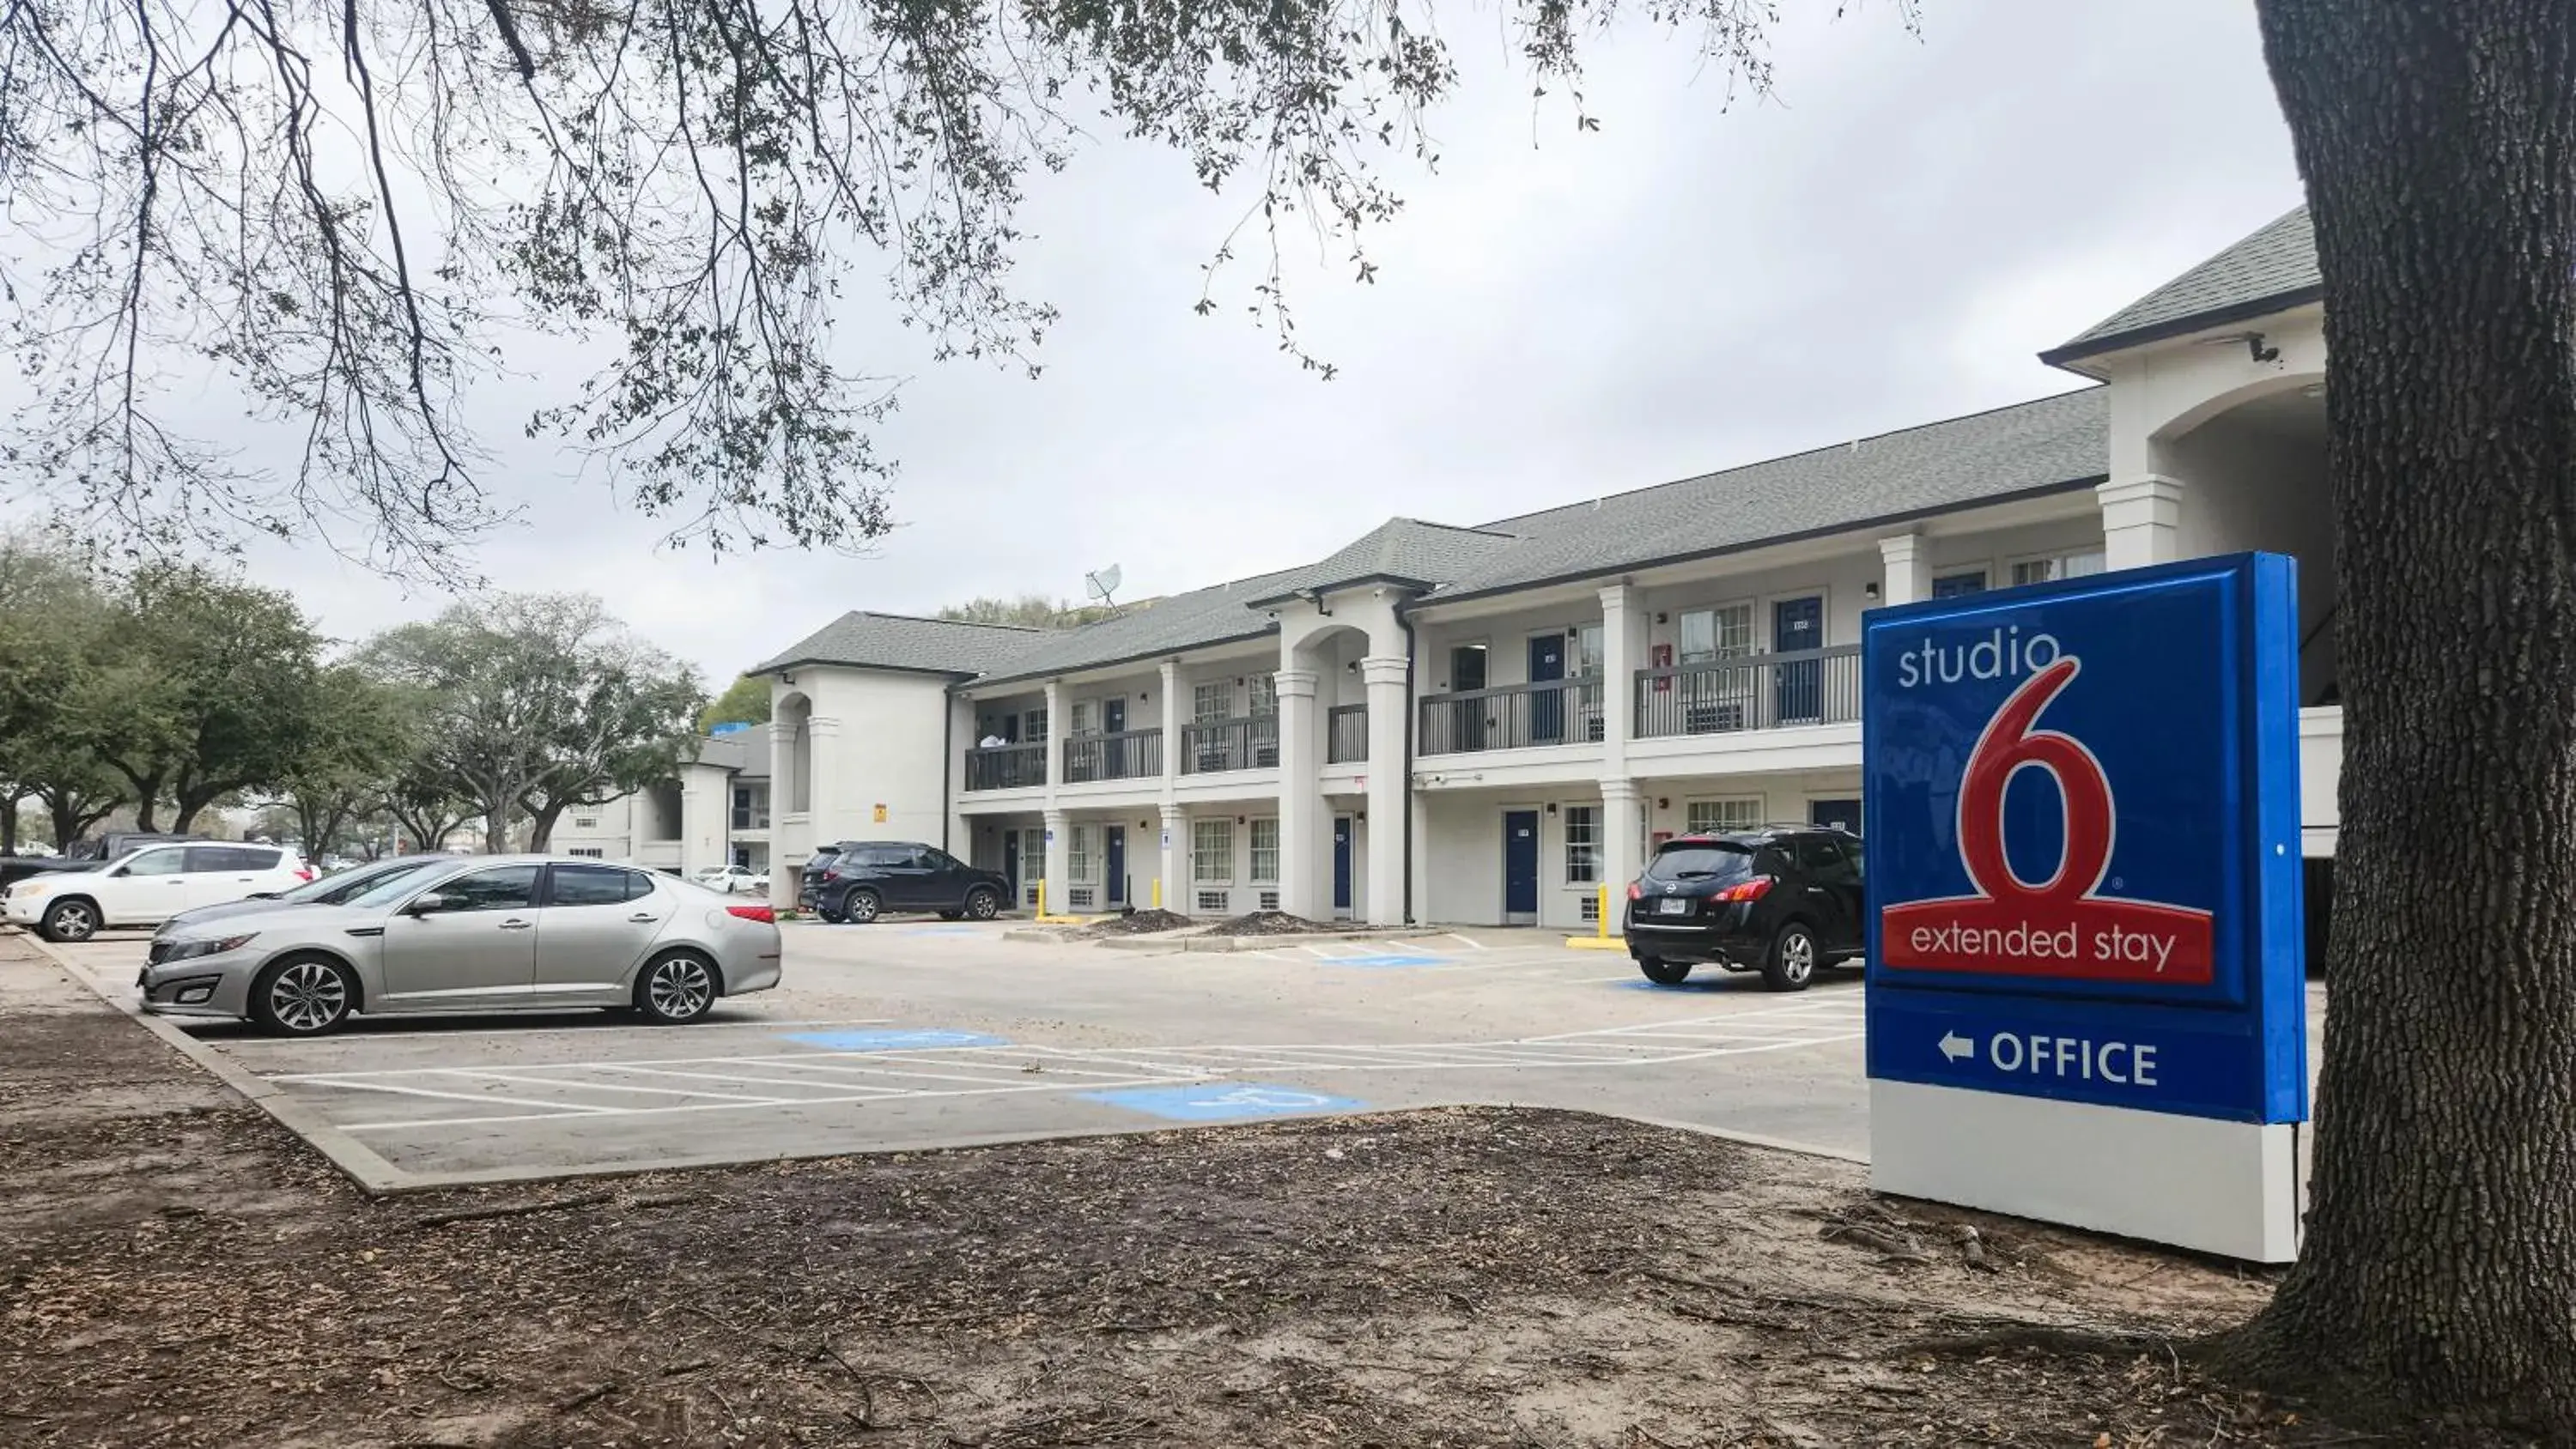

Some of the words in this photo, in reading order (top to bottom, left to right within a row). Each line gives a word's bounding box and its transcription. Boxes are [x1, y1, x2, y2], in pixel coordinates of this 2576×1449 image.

[1899, 625, 2060, 688] studio
[1956, 654, 2116, 903] 6
[1911, 920, 2077, 959] extended
[2094, 924, 2176, 973] stay
[1990, 1032, 2158, 1086] OFFICE
